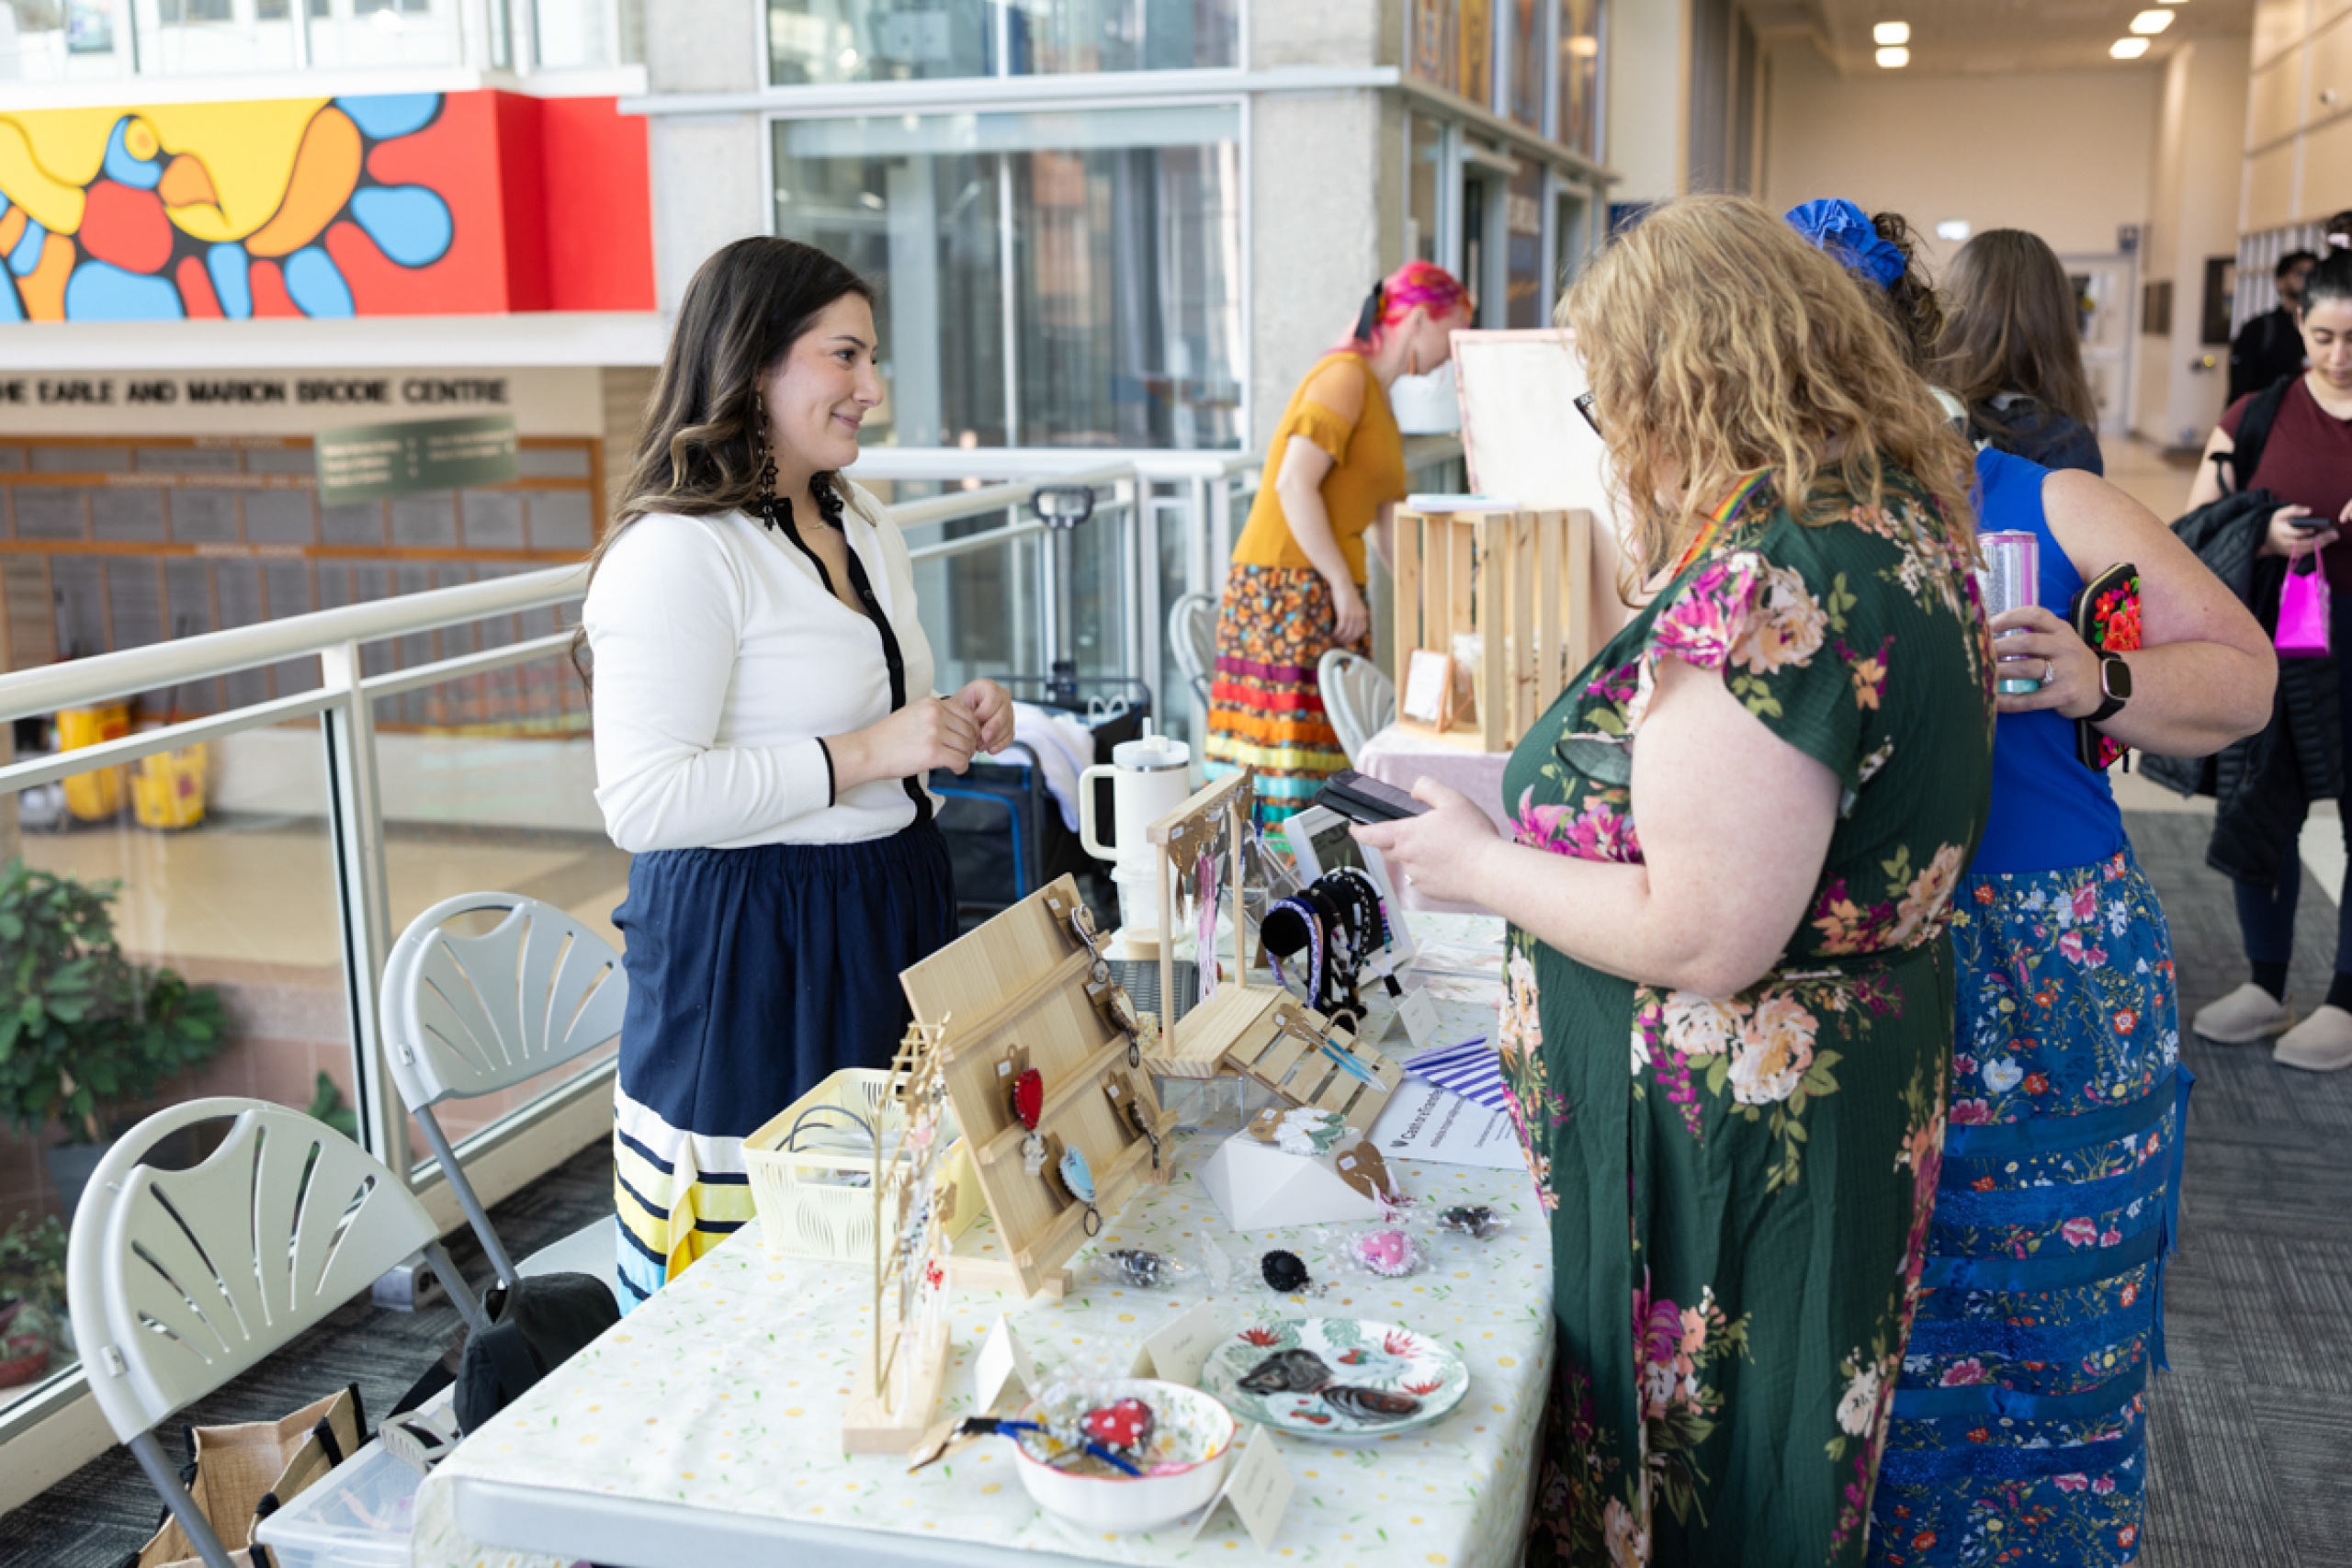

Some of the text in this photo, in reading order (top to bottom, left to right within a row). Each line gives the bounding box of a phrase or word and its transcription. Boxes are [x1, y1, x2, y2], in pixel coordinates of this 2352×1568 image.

[39, 378, 117, 406] EARLE
[127, 378, 178, 406] AND
[187, 378, 287, 405] MARION
[296, 378, 390, 405] BRODIE
[402, 378, 511, 405] CENTRE
